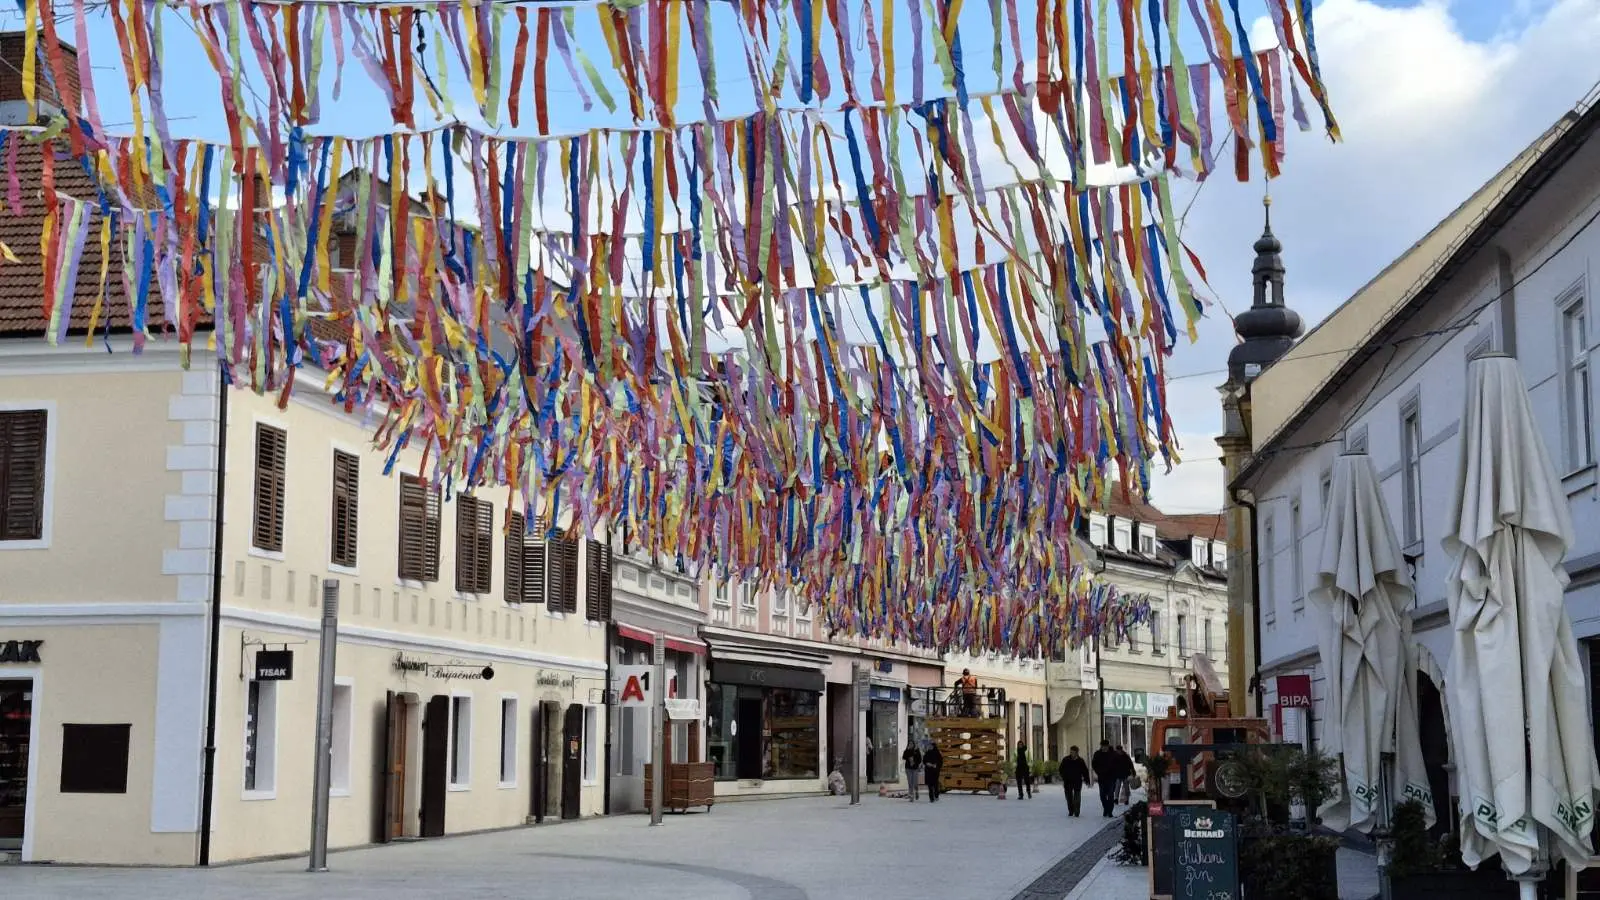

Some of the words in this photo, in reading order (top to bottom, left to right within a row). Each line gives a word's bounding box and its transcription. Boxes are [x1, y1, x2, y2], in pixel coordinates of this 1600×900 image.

[0, 640, 44, 663] AK
[259, 668, 287, 677] TISAK
[620, 671, 650, 701] A1
[1104, 690, 1145, 712] MODA
[1280, 695, 1310, 706] BIPA
[1183, 829, 1225, 839] BERNARD
